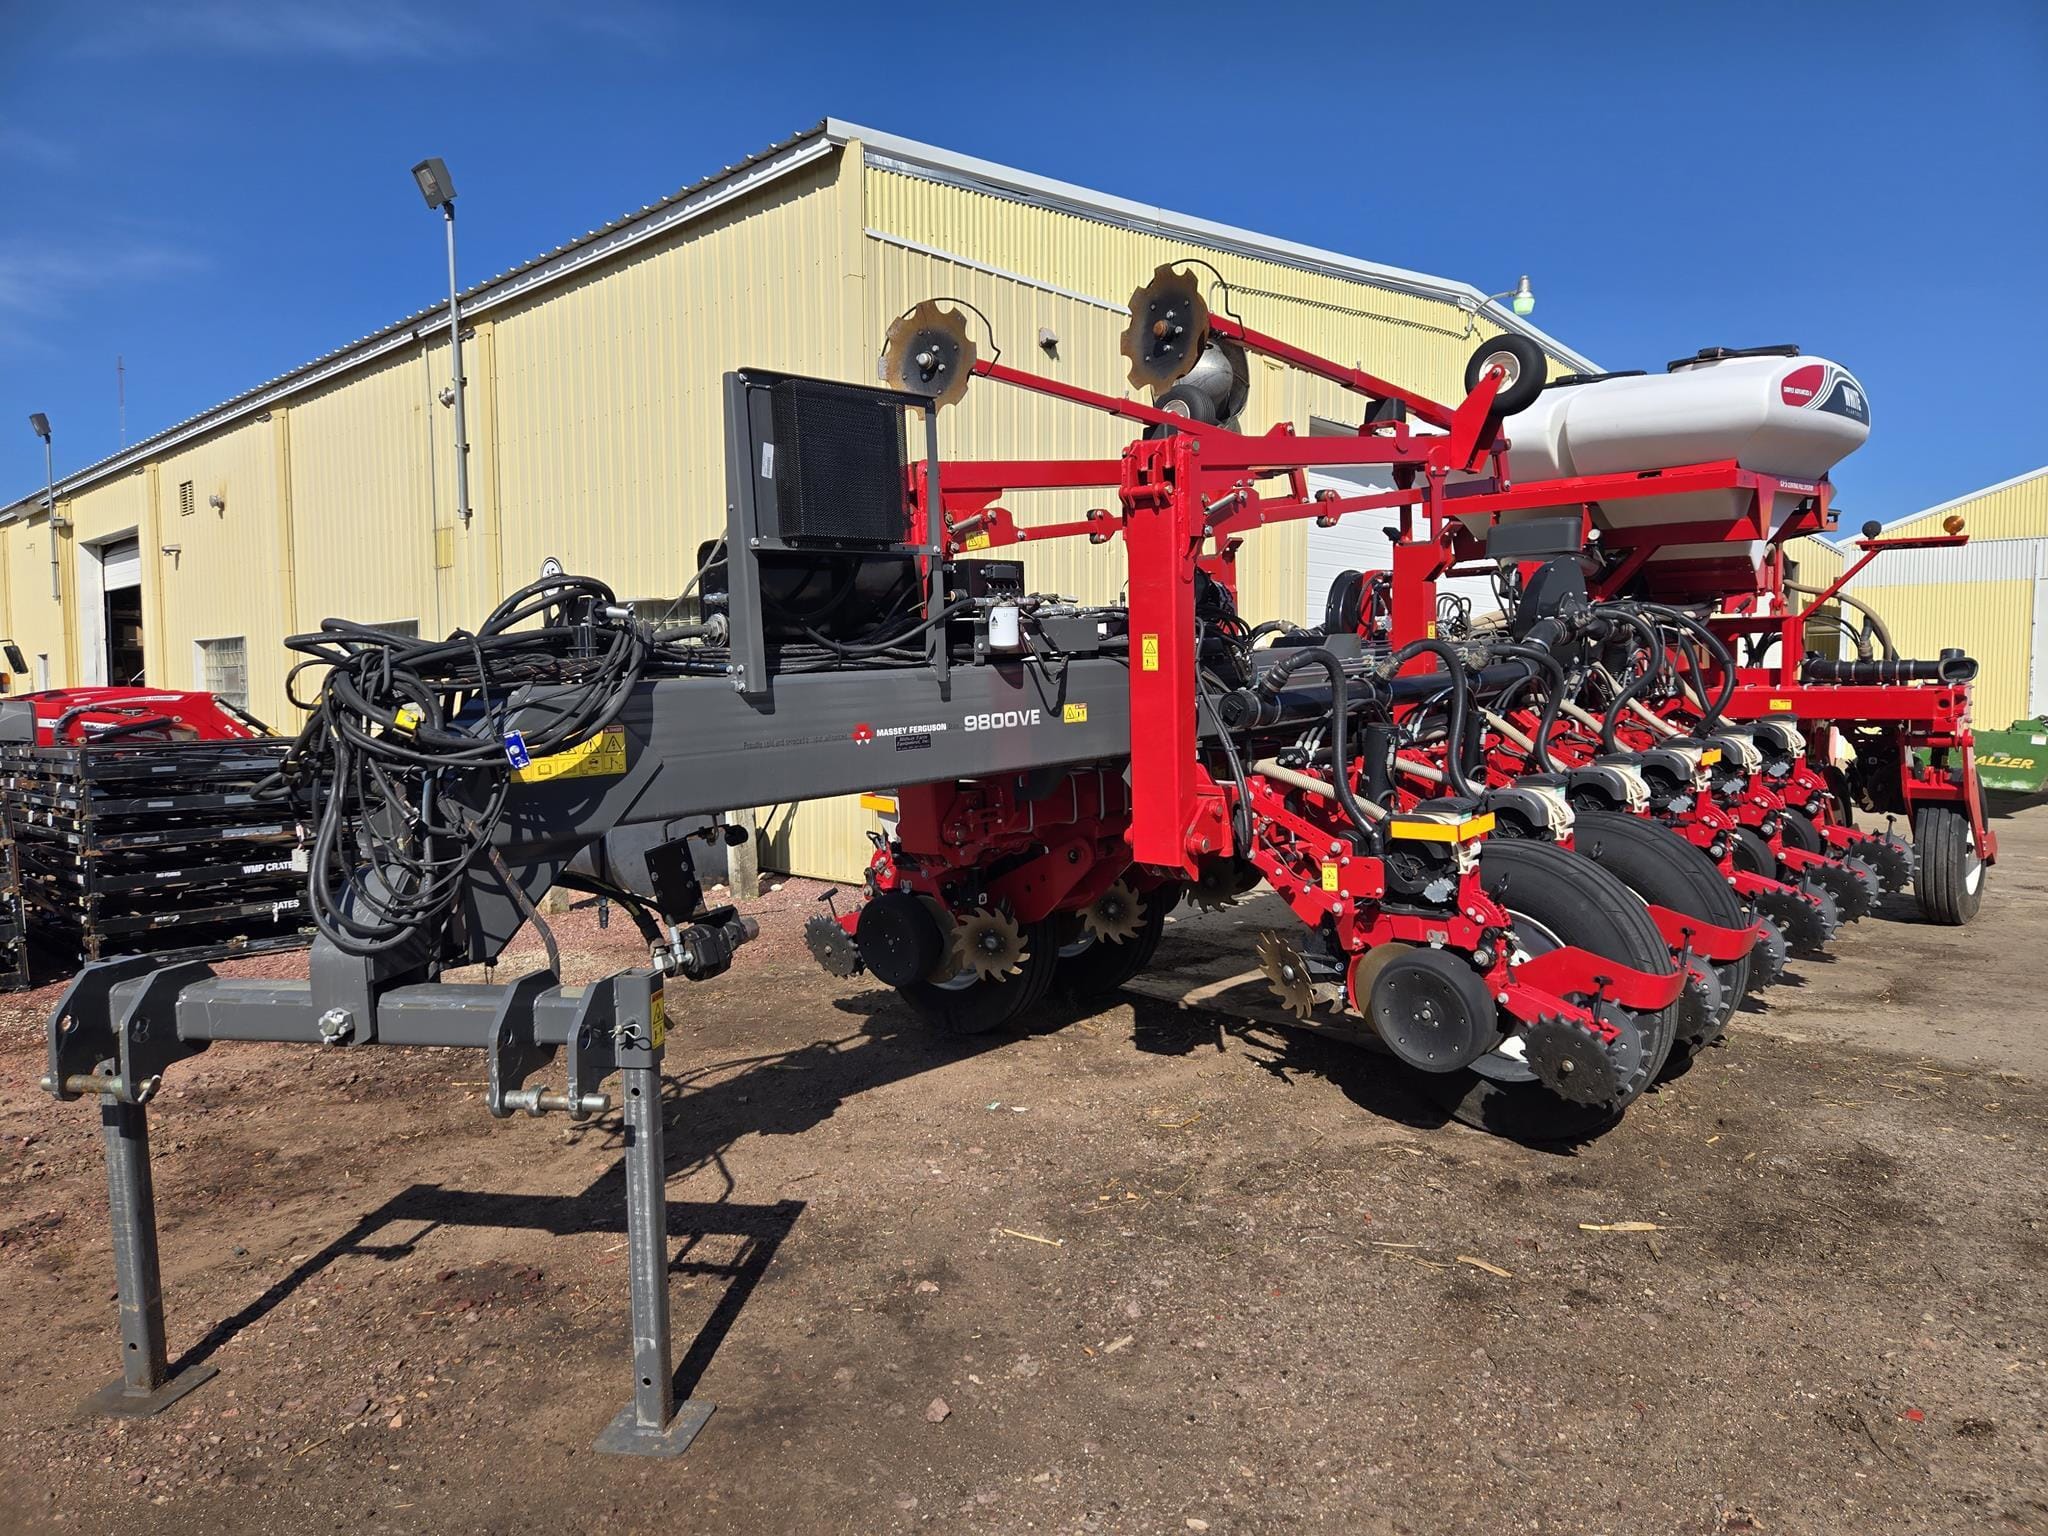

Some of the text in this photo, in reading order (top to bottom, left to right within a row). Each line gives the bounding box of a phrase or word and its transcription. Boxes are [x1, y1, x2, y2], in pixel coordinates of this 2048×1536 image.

[964, 709, 1041, 731] 9800VE
[876, 726, 907, 737] MASSEY
[909, 722, 947, 733] FERGUSON
[1975, 755, 2034, 769] ALZER
[243, 860, 292, 874] WMP CRATE
[272, 899, 300, 910] RATES
